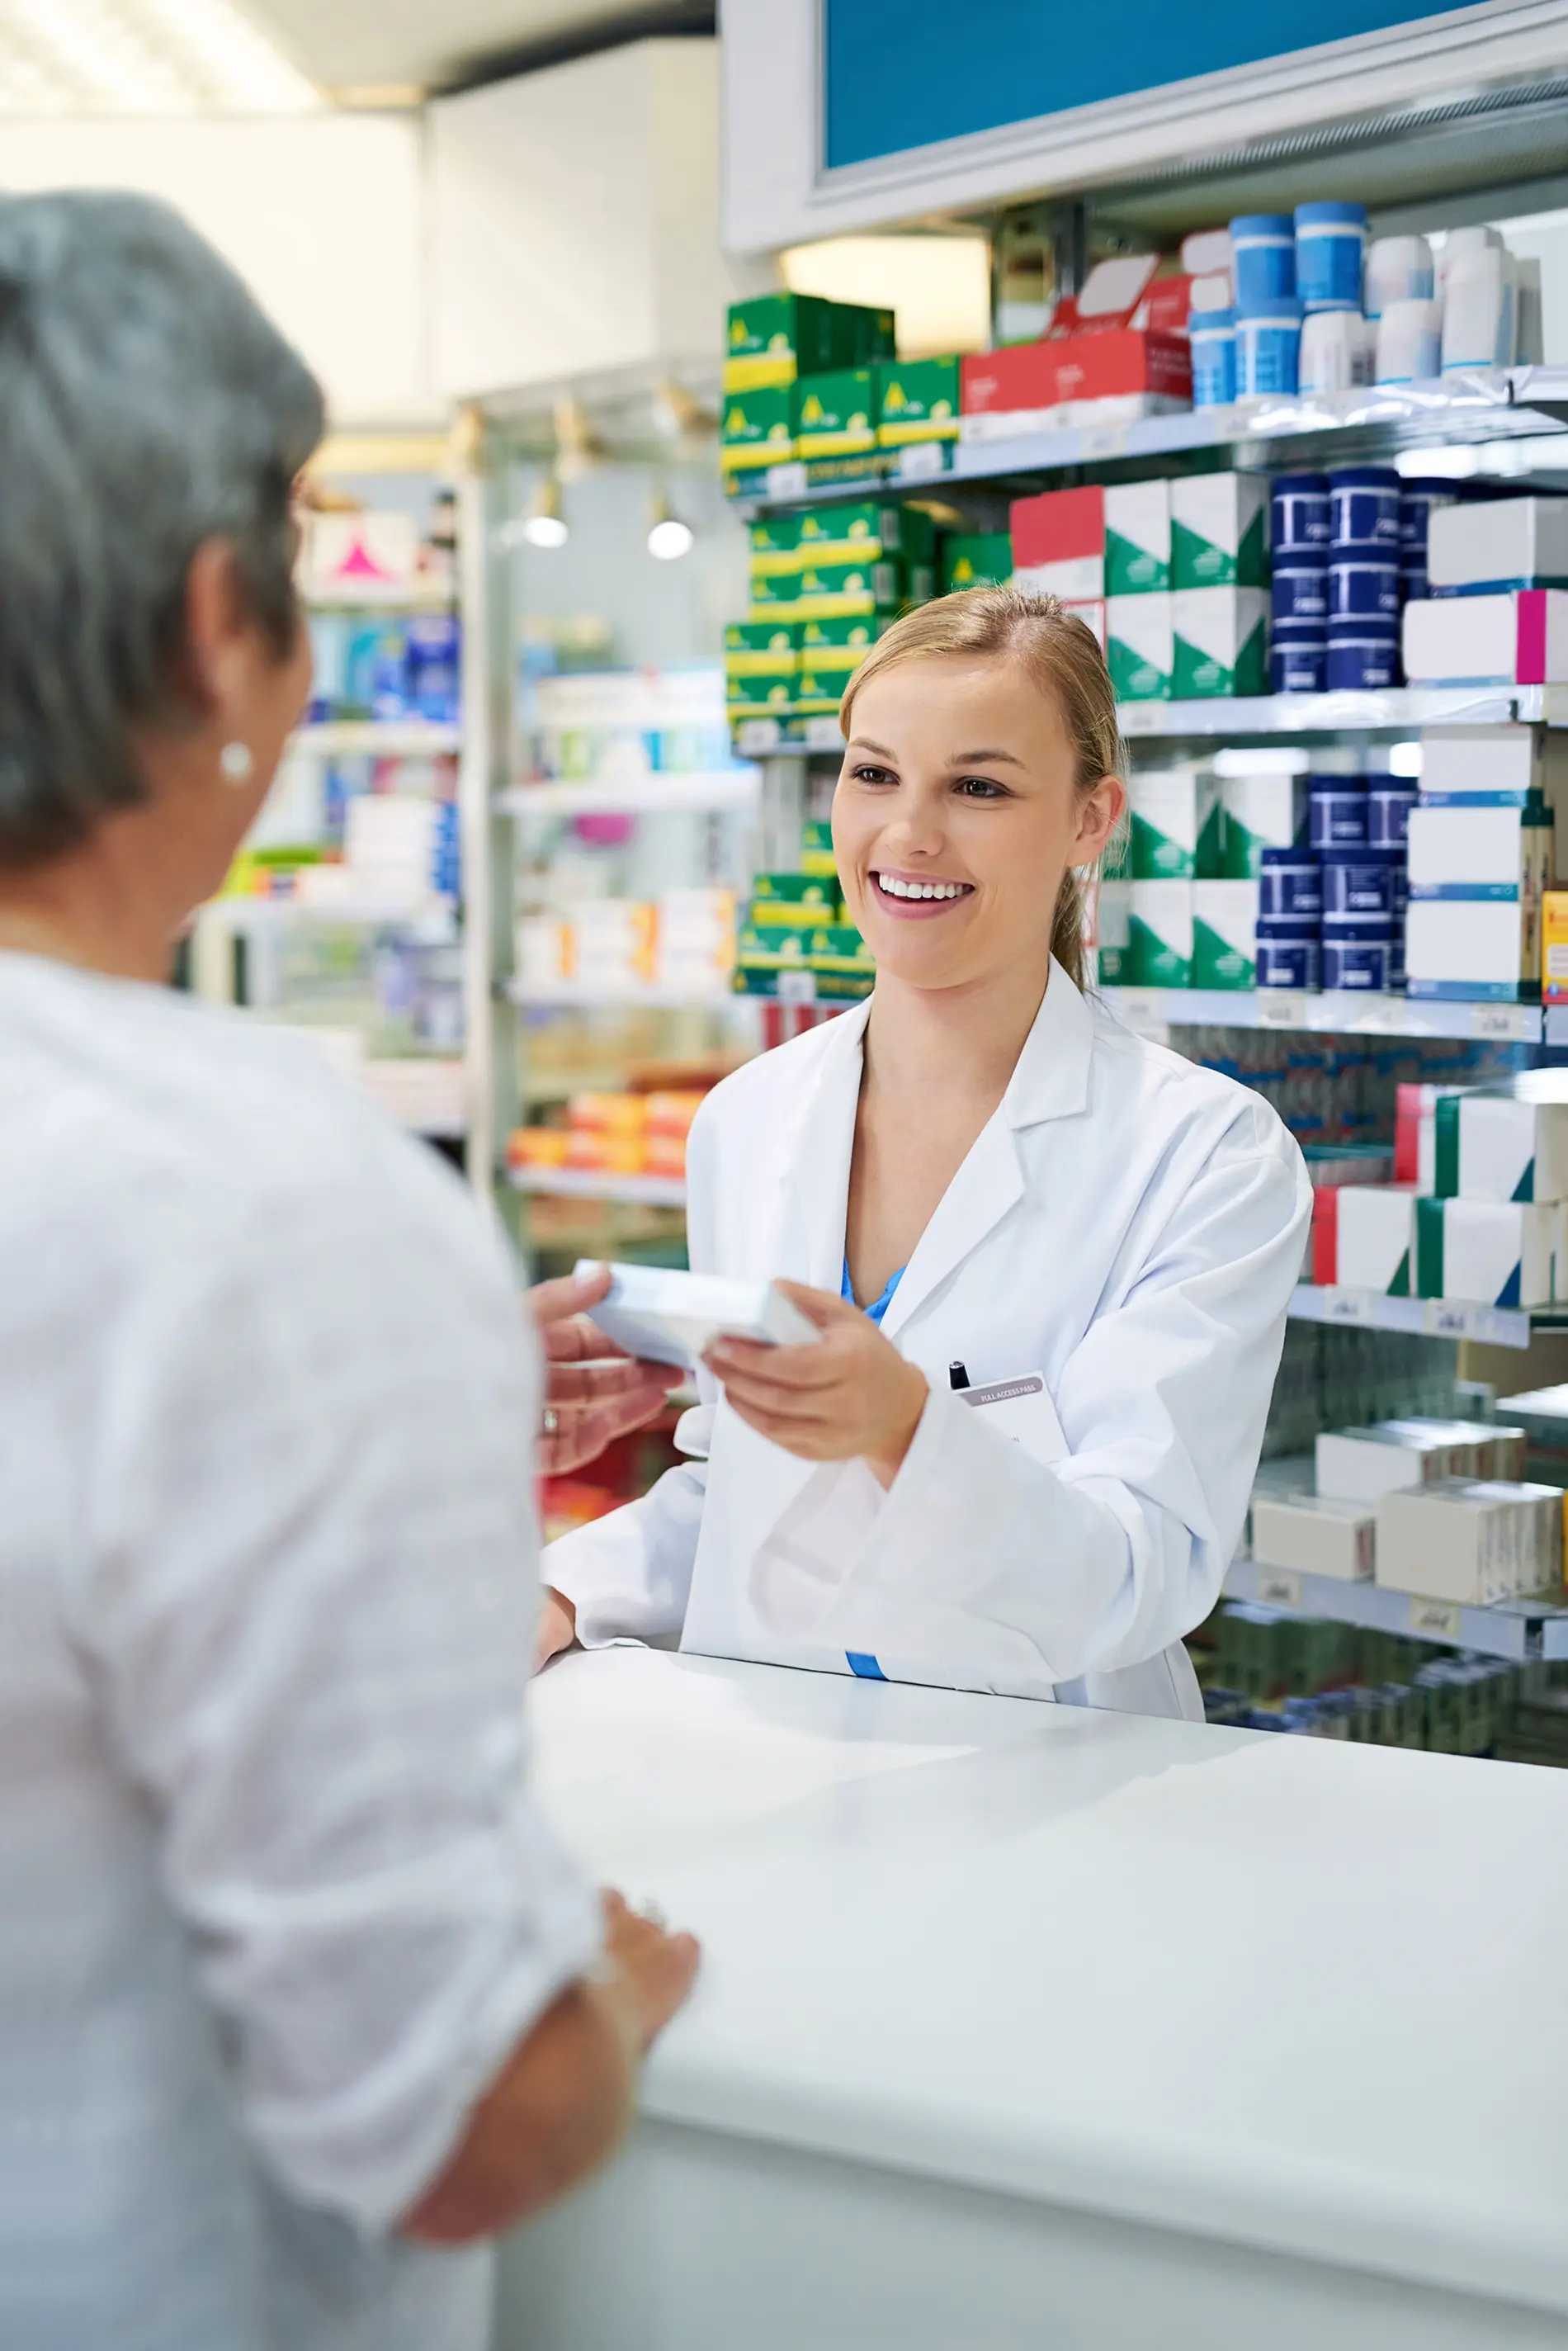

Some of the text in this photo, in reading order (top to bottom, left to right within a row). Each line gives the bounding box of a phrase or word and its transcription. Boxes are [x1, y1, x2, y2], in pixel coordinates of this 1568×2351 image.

[981, 1384, 1037, 1402] FULL ACCESS PASS
